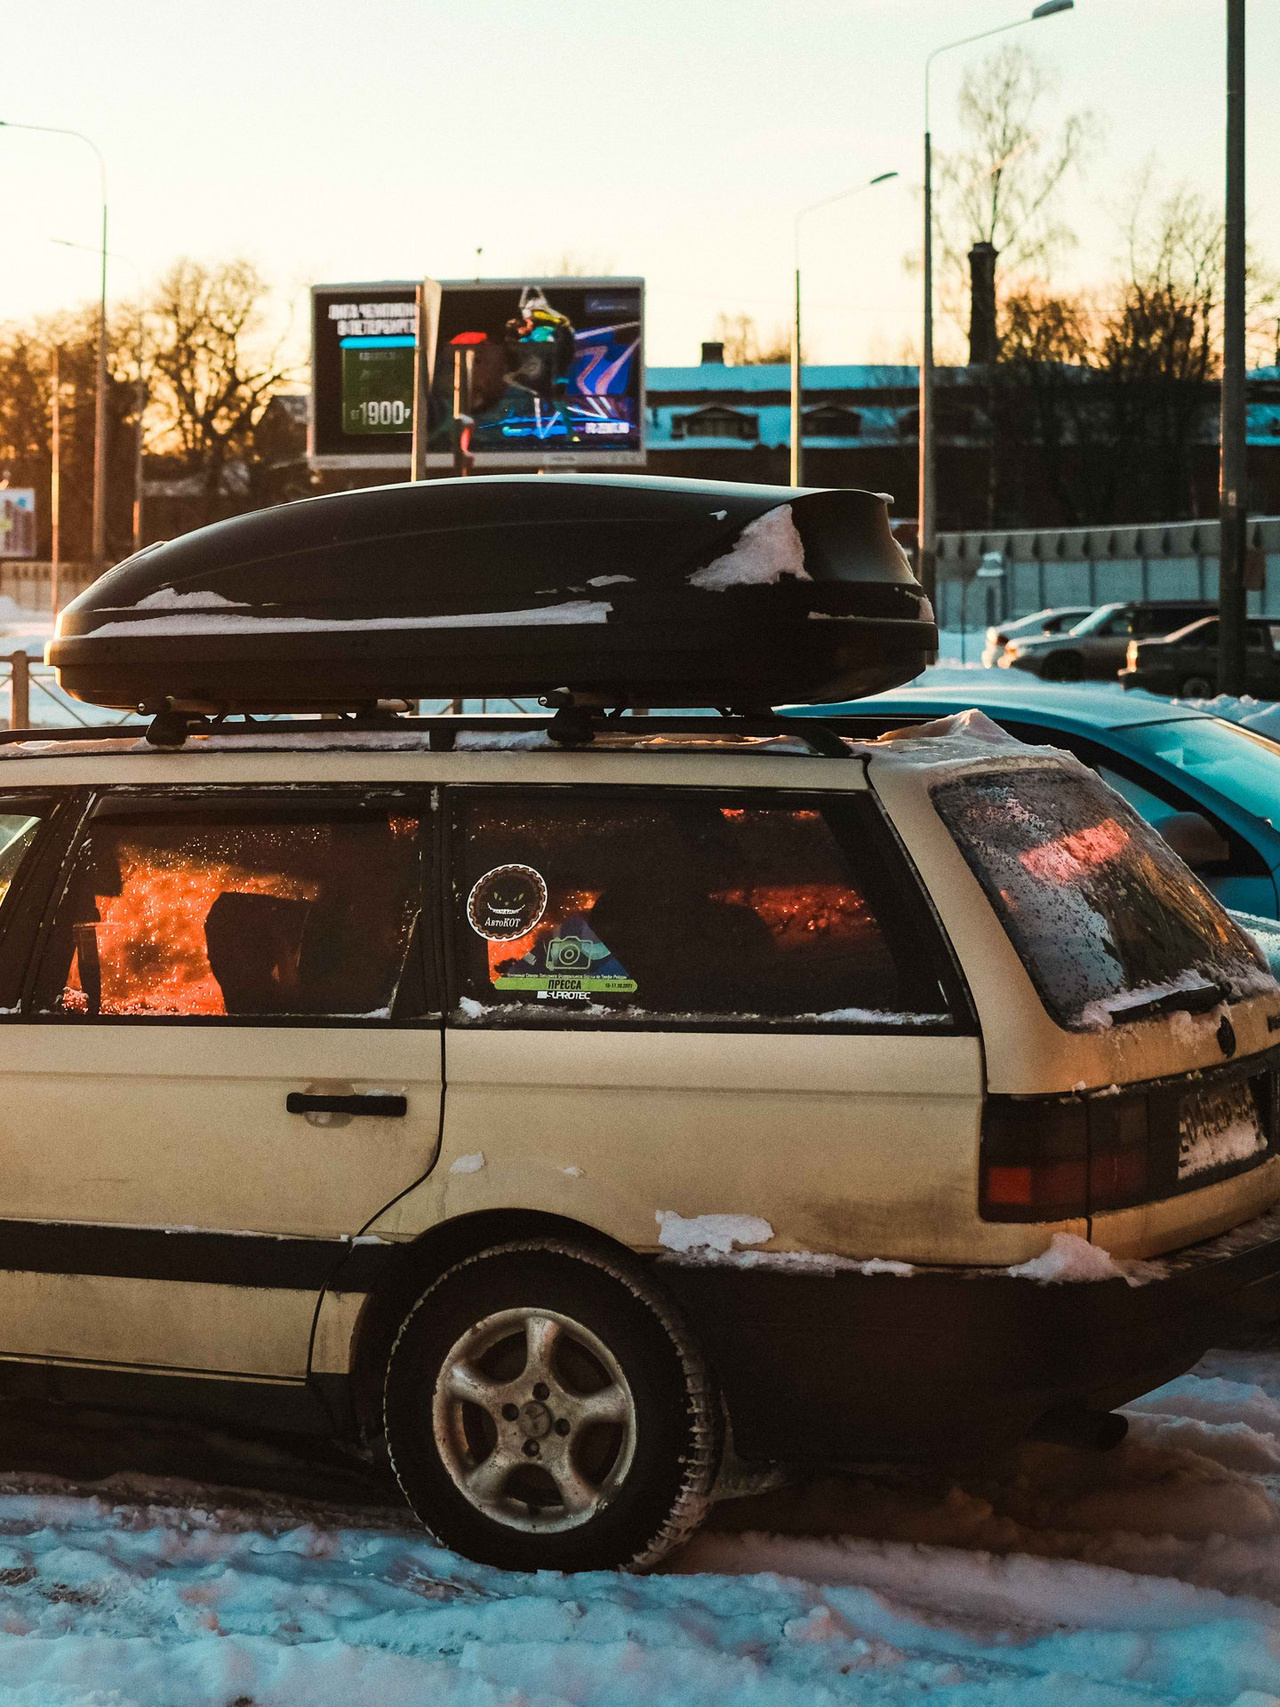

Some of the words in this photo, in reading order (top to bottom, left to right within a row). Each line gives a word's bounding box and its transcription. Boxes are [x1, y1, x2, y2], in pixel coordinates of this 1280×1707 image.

[484, 916, 522, 928] АвтоКОТ
[548, 979, 582, 990] ПРЕССА
[546, 991, 591, 1000] SUPROTEC
